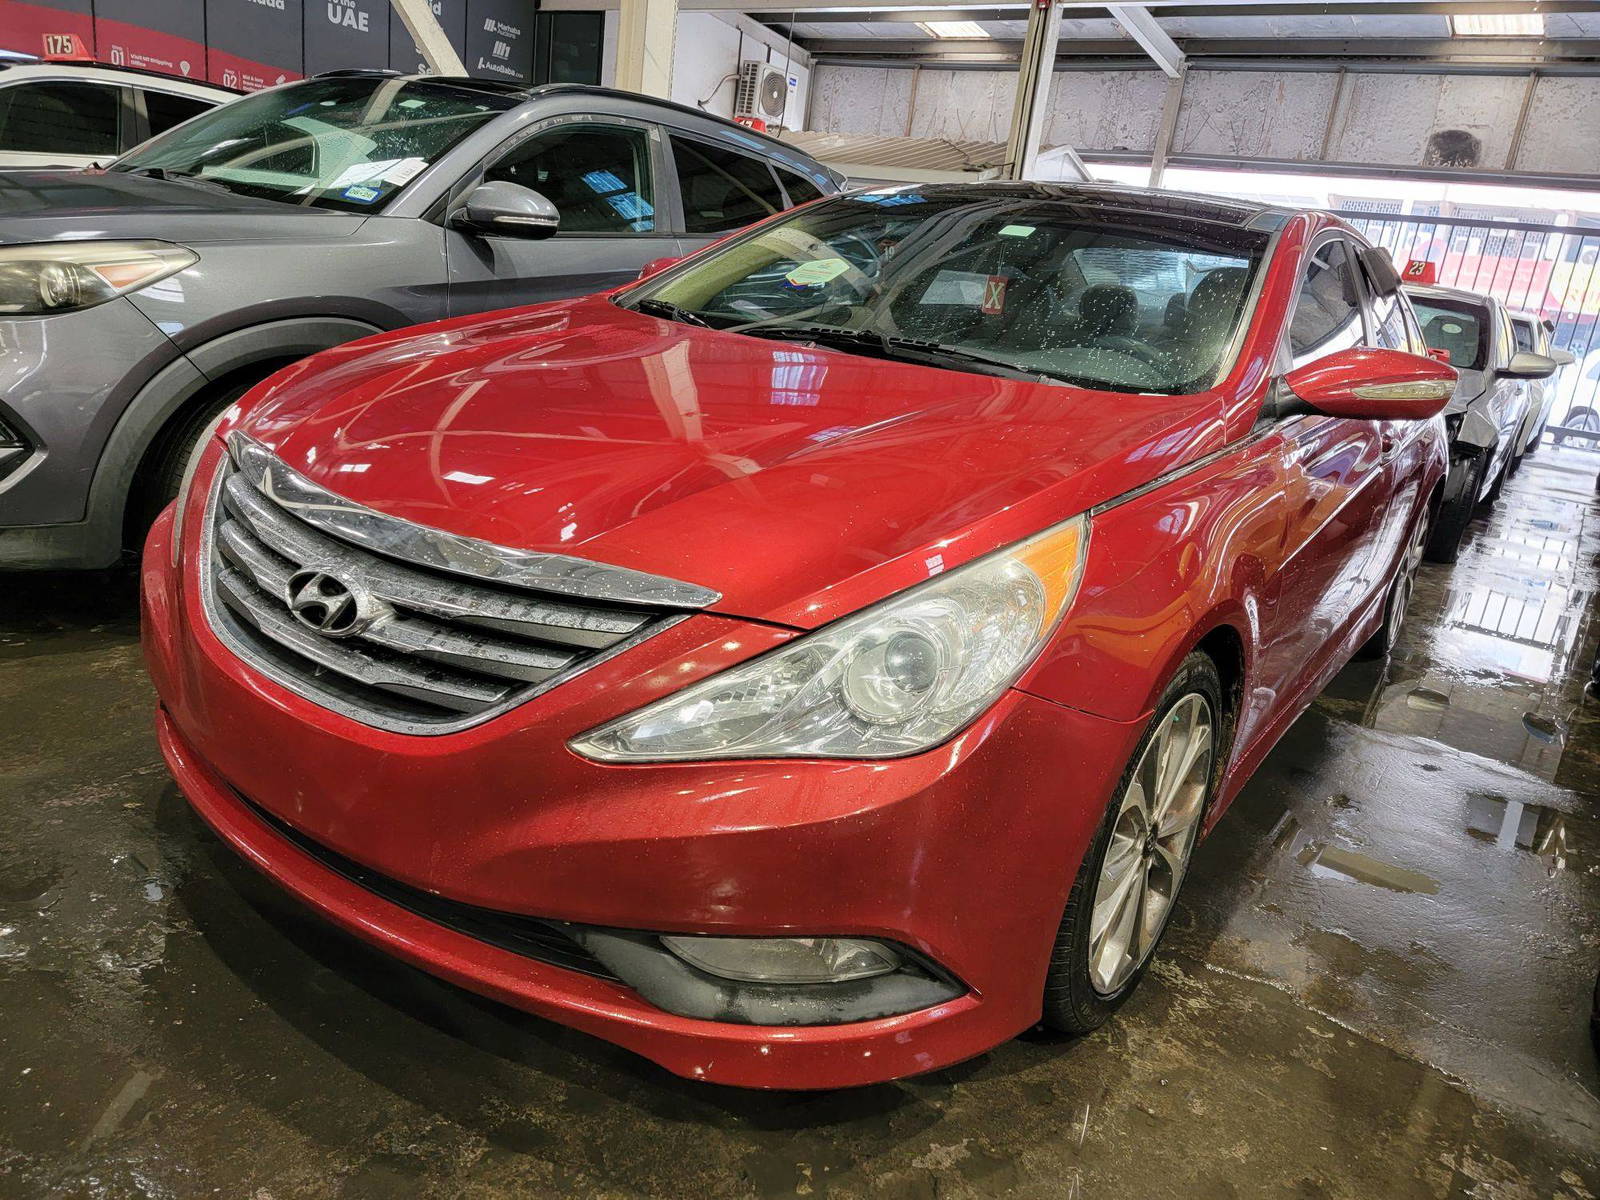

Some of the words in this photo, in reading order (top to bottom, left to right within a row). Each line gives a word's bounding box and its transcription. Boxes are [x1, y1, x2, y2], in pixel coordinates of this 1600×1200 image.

[328, 3, 369, 32] UAE
[47, 35, 73, 55] 175
[110, 49, 125, 66] 01
[223, 73, 238, 89] 02
[1409, 261, 1426, 276] 23
